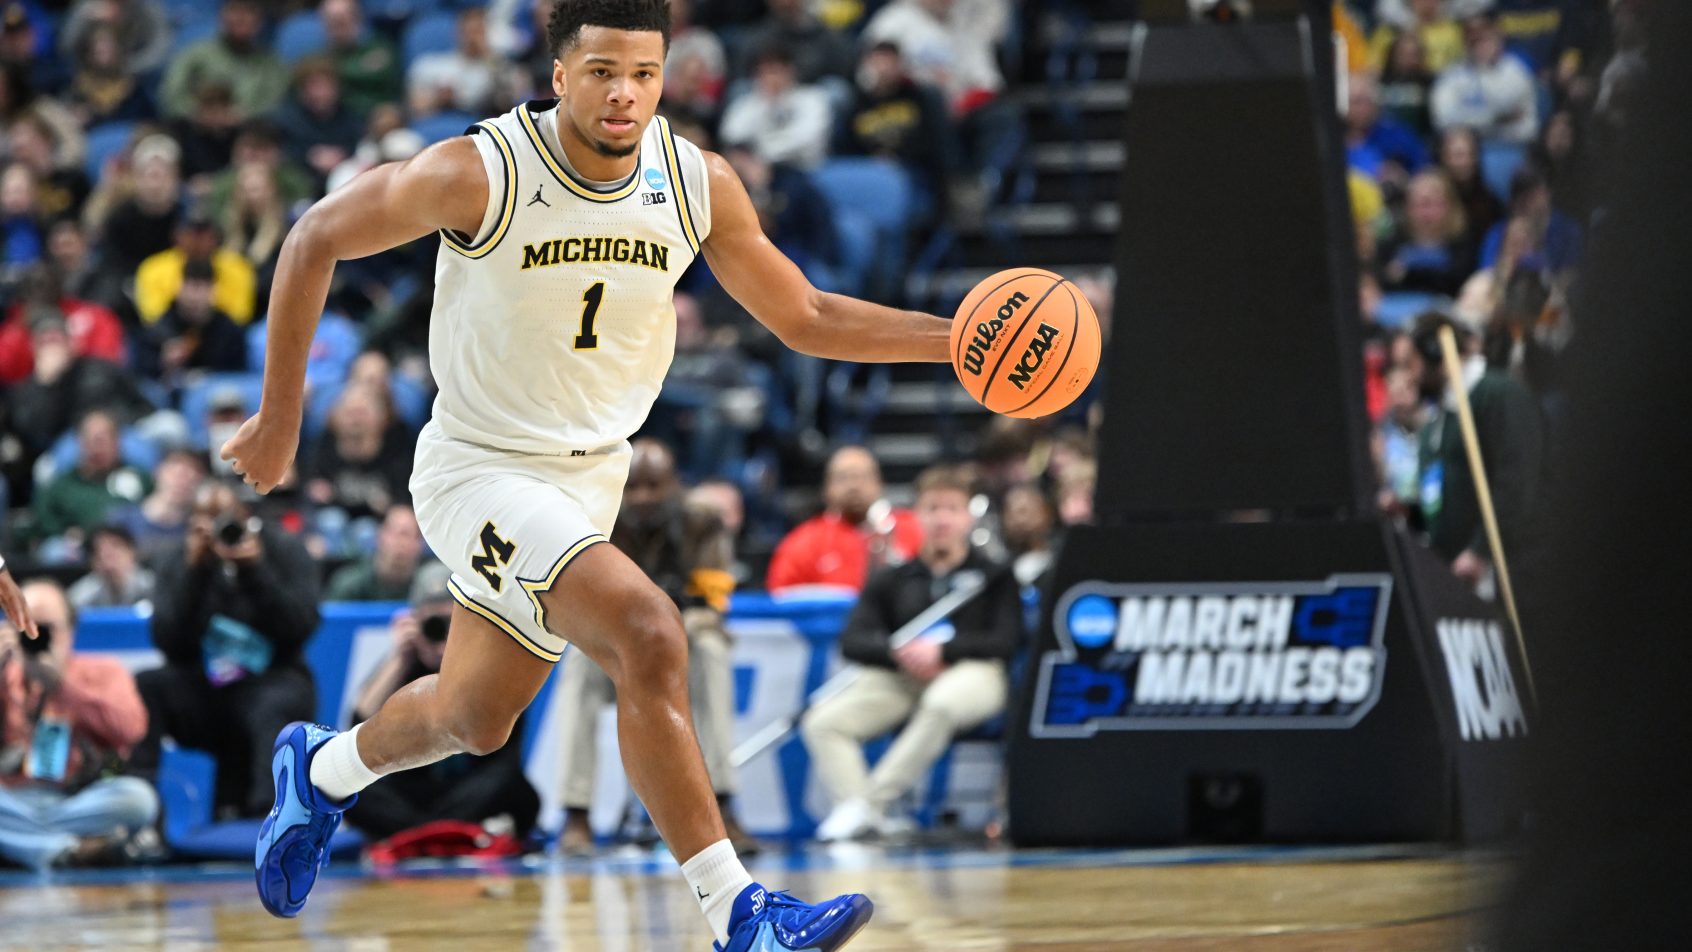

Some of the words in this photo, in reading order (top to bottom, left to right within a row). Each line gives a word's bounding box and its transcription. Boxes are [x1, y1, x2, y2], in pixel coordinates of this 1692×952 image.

[520, 237, 669, 272] MICHIGAN
[572, 281, 605, 351] 1
[963, 291, 1030, 376] Wilson
[1007, 322, 1059, 390] NCAA
[471, 520, 517, 593] M
[1115, 595, 1295, 651] MARCH
[1134, 646, 1375, 705] MADNESS
[1435, 617, 1529, 742] NCAA
